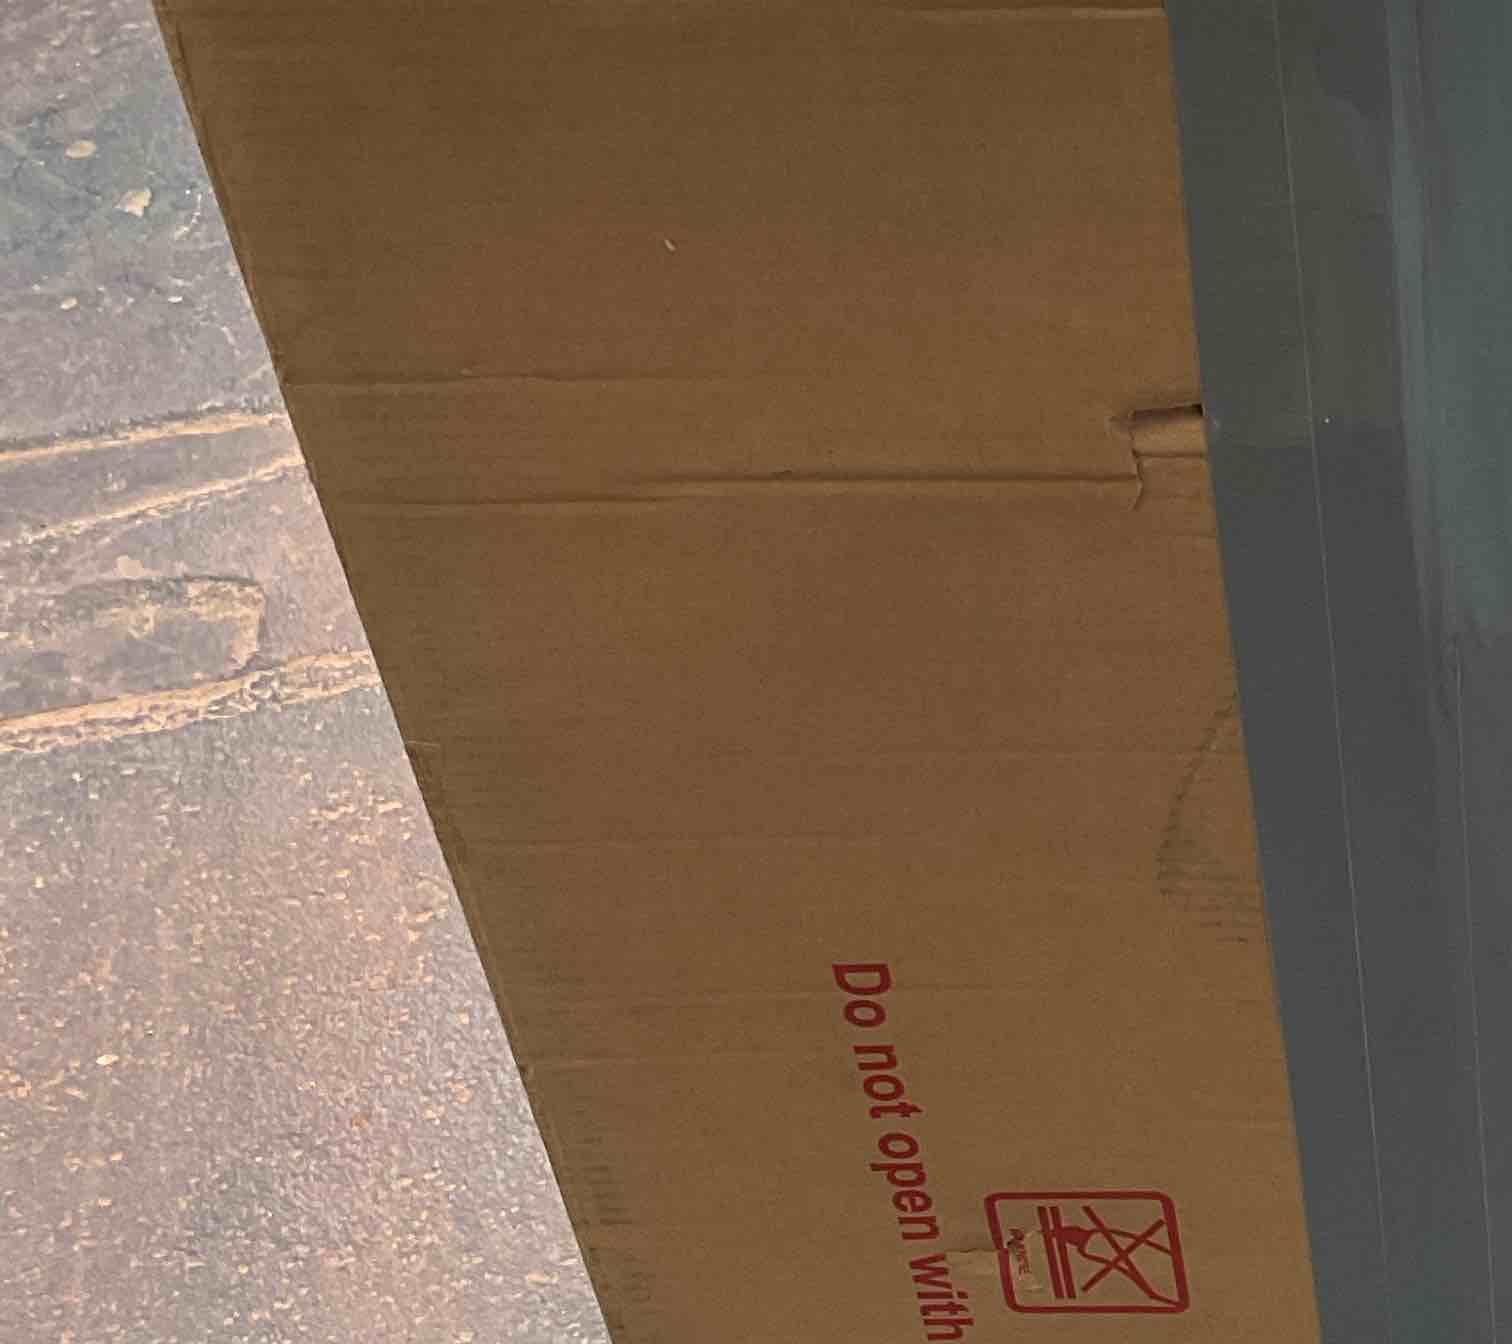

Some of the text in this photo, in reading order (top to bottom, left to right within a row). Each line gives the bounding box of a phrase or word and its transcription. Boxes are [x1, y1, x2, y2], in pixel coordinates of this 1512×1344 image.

[832, 963, 892, 1028] Do
[853, 1044, 922, 1119] not
[869, 1132, 940, 1241] open
[909, 1253, 975, 1341] with
